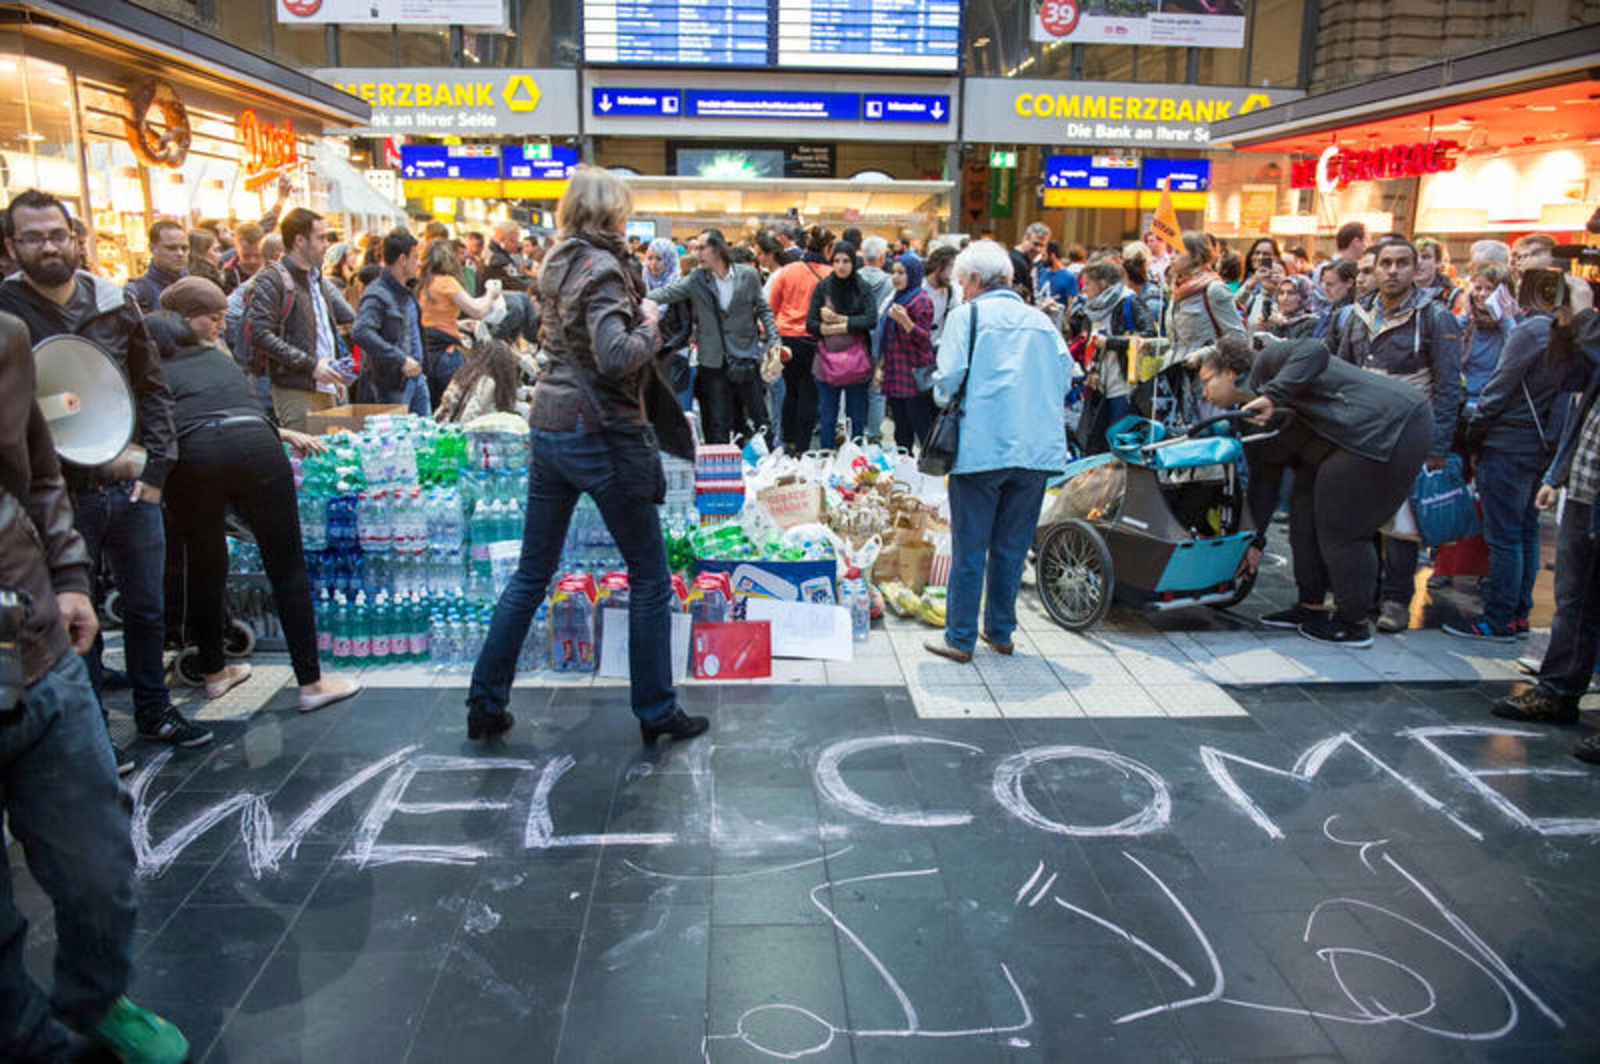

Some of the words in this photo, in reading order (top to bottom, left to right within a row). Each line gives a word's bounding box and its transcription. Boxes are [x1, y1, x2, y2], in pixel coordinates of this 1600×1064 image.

[1044, 2, 1075, 25] 39
[335, 82, 495, 107] ERZBANK
[1014, 93, 1232, 122] COMMERZBANK
[371, 112, 390, 127] nk
[417, 112, 454, 127] Ihrer
[458, 112, 497, 127] Seite
[1067, 123, 1092, 138] Die
[1096, 123, 1131, 139] Bank
[1135, 127, 1152, 139] an
[1156, 126, 1192, 141] Ihrer
